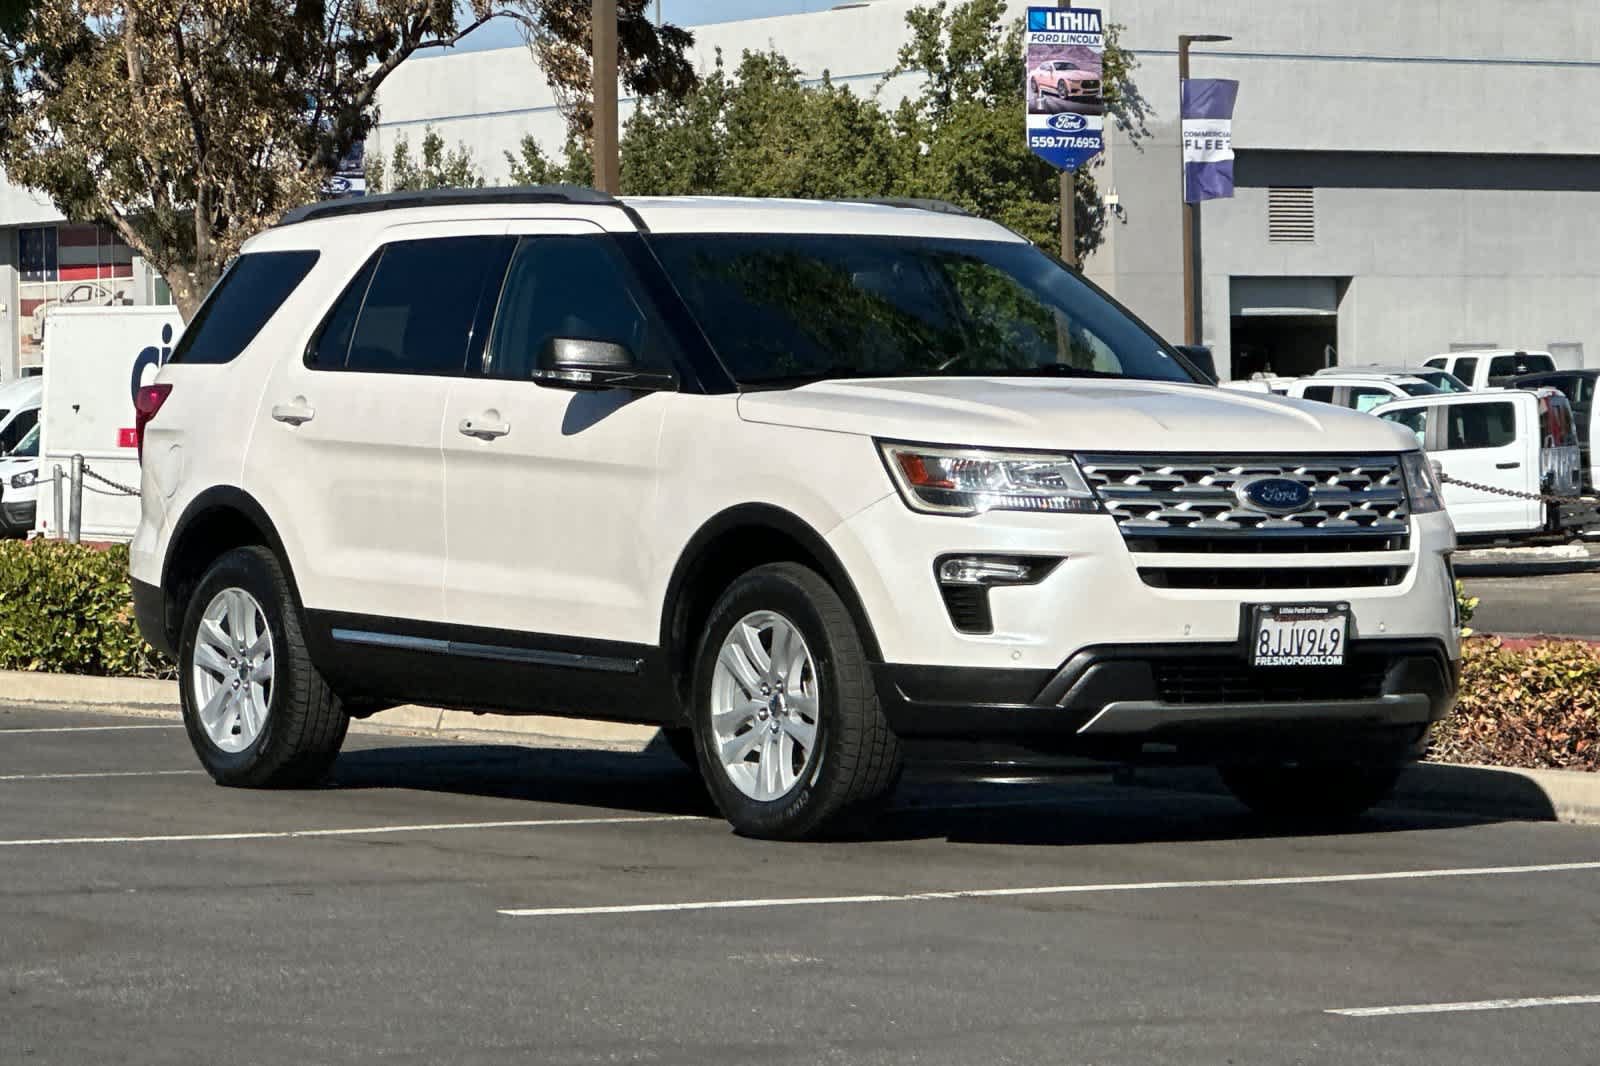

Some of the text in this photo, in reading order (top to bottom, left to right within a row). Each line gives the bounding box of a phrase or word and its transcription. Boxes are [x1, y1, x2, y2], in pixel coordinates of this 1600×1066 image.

[1046, 11, 1100, 32] LITHIA
[1031, 33, 1100, 44] FORD LINCOLN
[1055, 114, 1082, 129] Ford
[1031, 136, 1100, 149] 559.777.6952
[1261, 484, 1298, 501] Ford
[1259, 628, 1340, 656] 8JJV949
[1255, 655, 1342, 666] FRESNOFORD.COM
